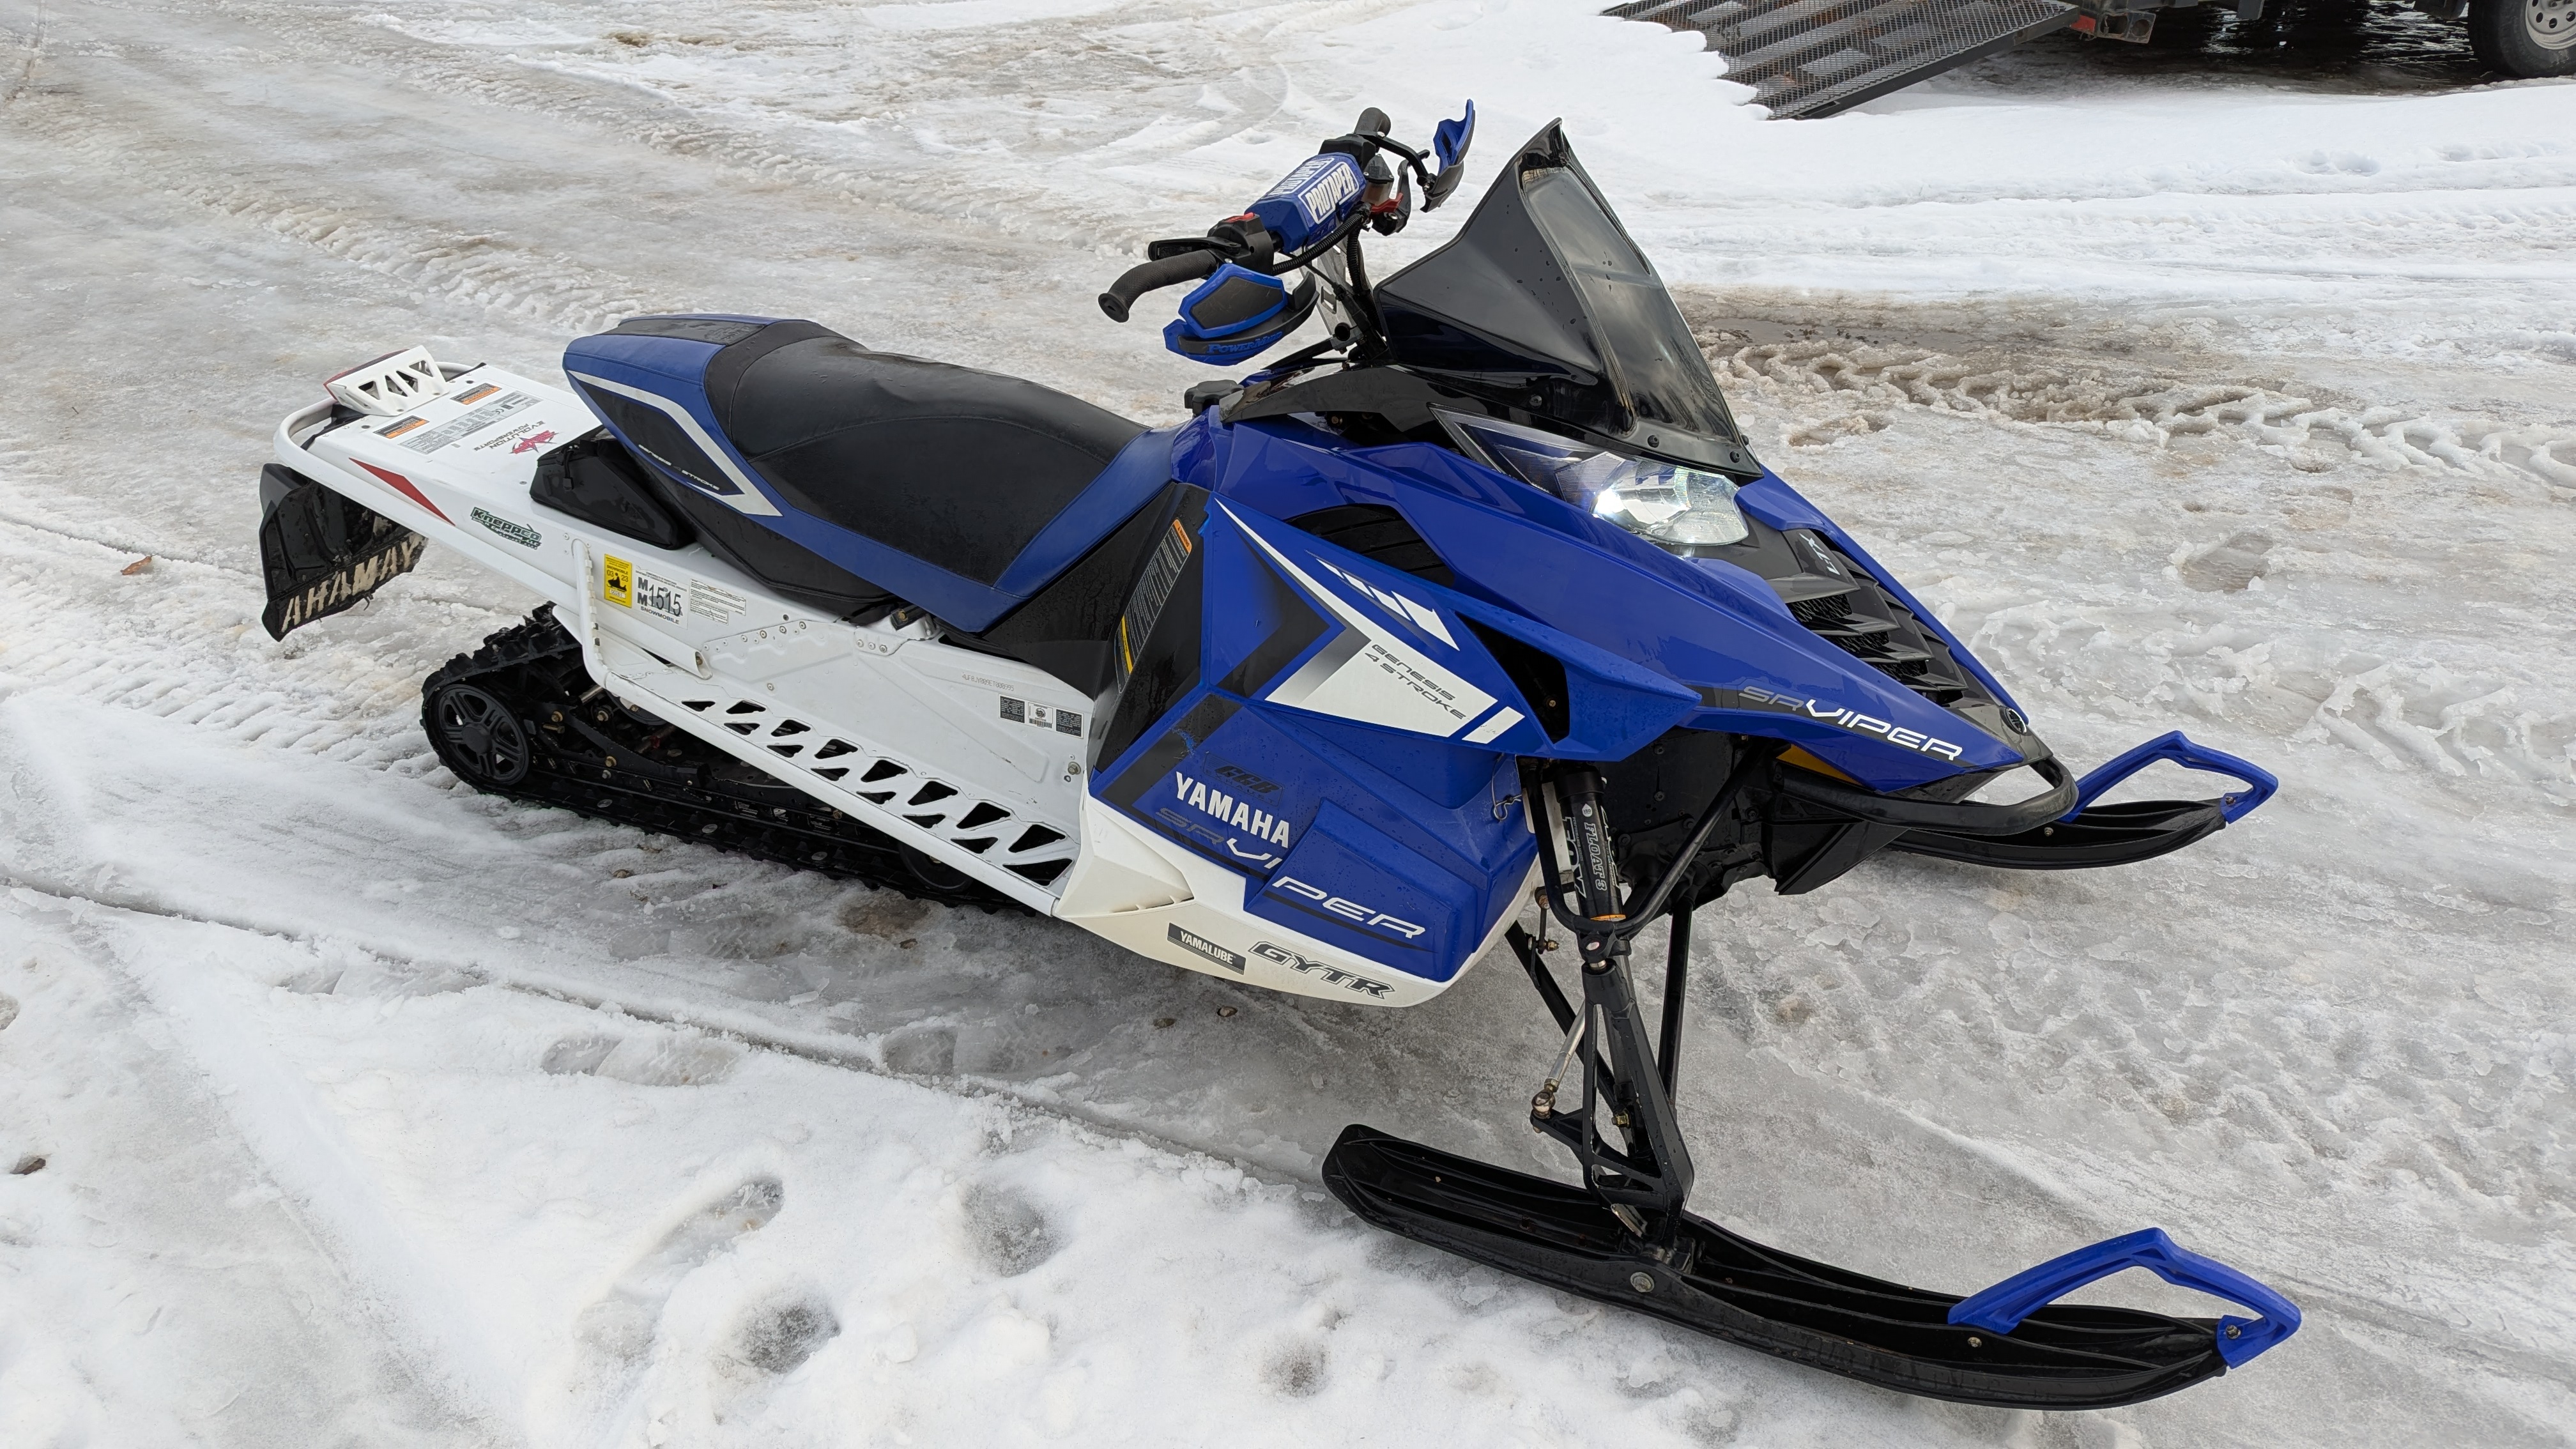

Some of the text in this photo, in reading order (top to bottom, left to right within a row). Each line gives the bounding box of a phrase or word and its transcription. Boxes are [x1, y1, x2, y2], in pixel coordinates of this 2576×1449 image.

[1304, 163, 1356, 222] PROTAPER
[473, 424, 529, 451] POWERSPORTS
[489, 421, 545, 448] EVOLUTION
[471, 509, 541, 542] Kneppco
[637, 592, 648, 606] M
[638, 576, 648, 592] M
[648, 584, 681, 617] 1515
[640, 606, 680, 625] SNOWMOBILE
[1365, 652, 1466, 719] 4 STROKE
[1372, 644, 1456, 701] GENESIS
[1806, 699, 1963, 761] VIPER
[1176, 771, 1289, 849] YAMAHA
[1584, 822, 1607, 891] FLOAT 3
[1180, 930, 1234, 965] YAMALUBE
[1247, 940, 1396, 1000] GYTR
